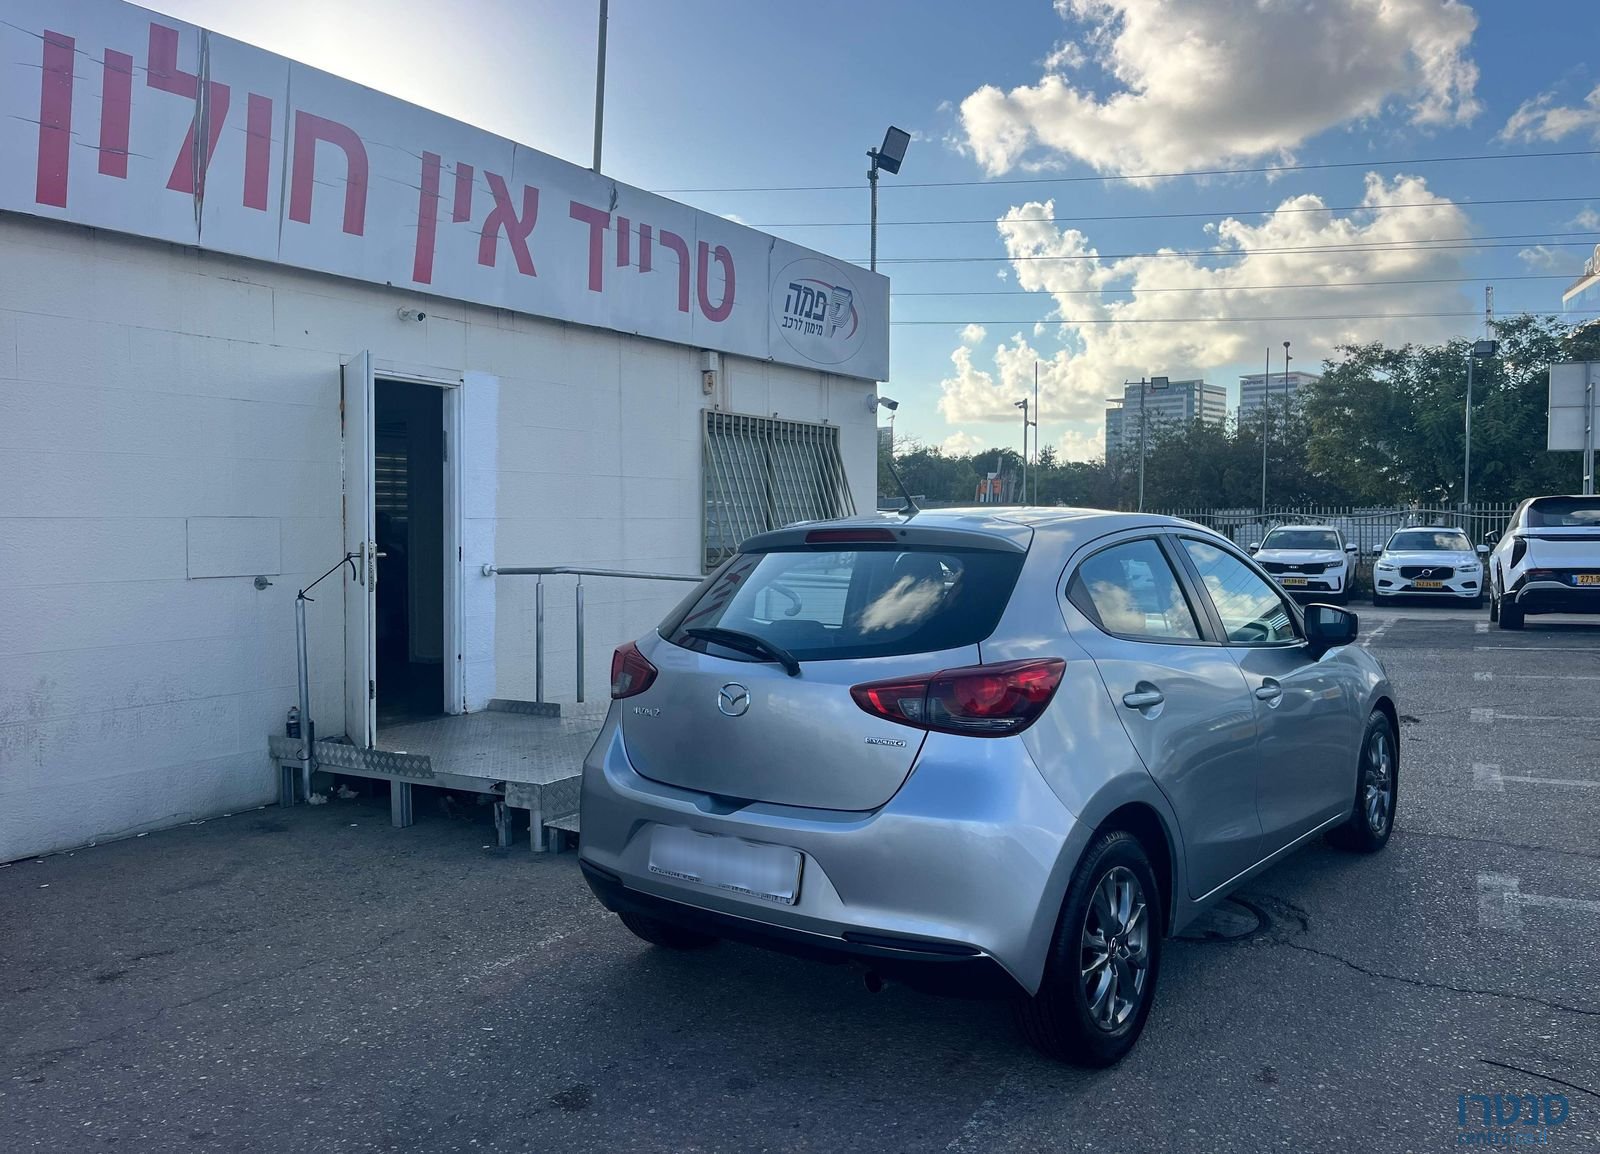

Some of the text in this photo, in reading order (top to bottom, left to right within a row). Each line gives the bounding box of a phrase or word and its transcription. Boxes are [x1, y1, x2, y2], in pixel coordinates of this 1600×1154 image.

[36, 22, 736, 322] טרייד אין חולון
[782, 316, 823, 336] מימון לרכב
